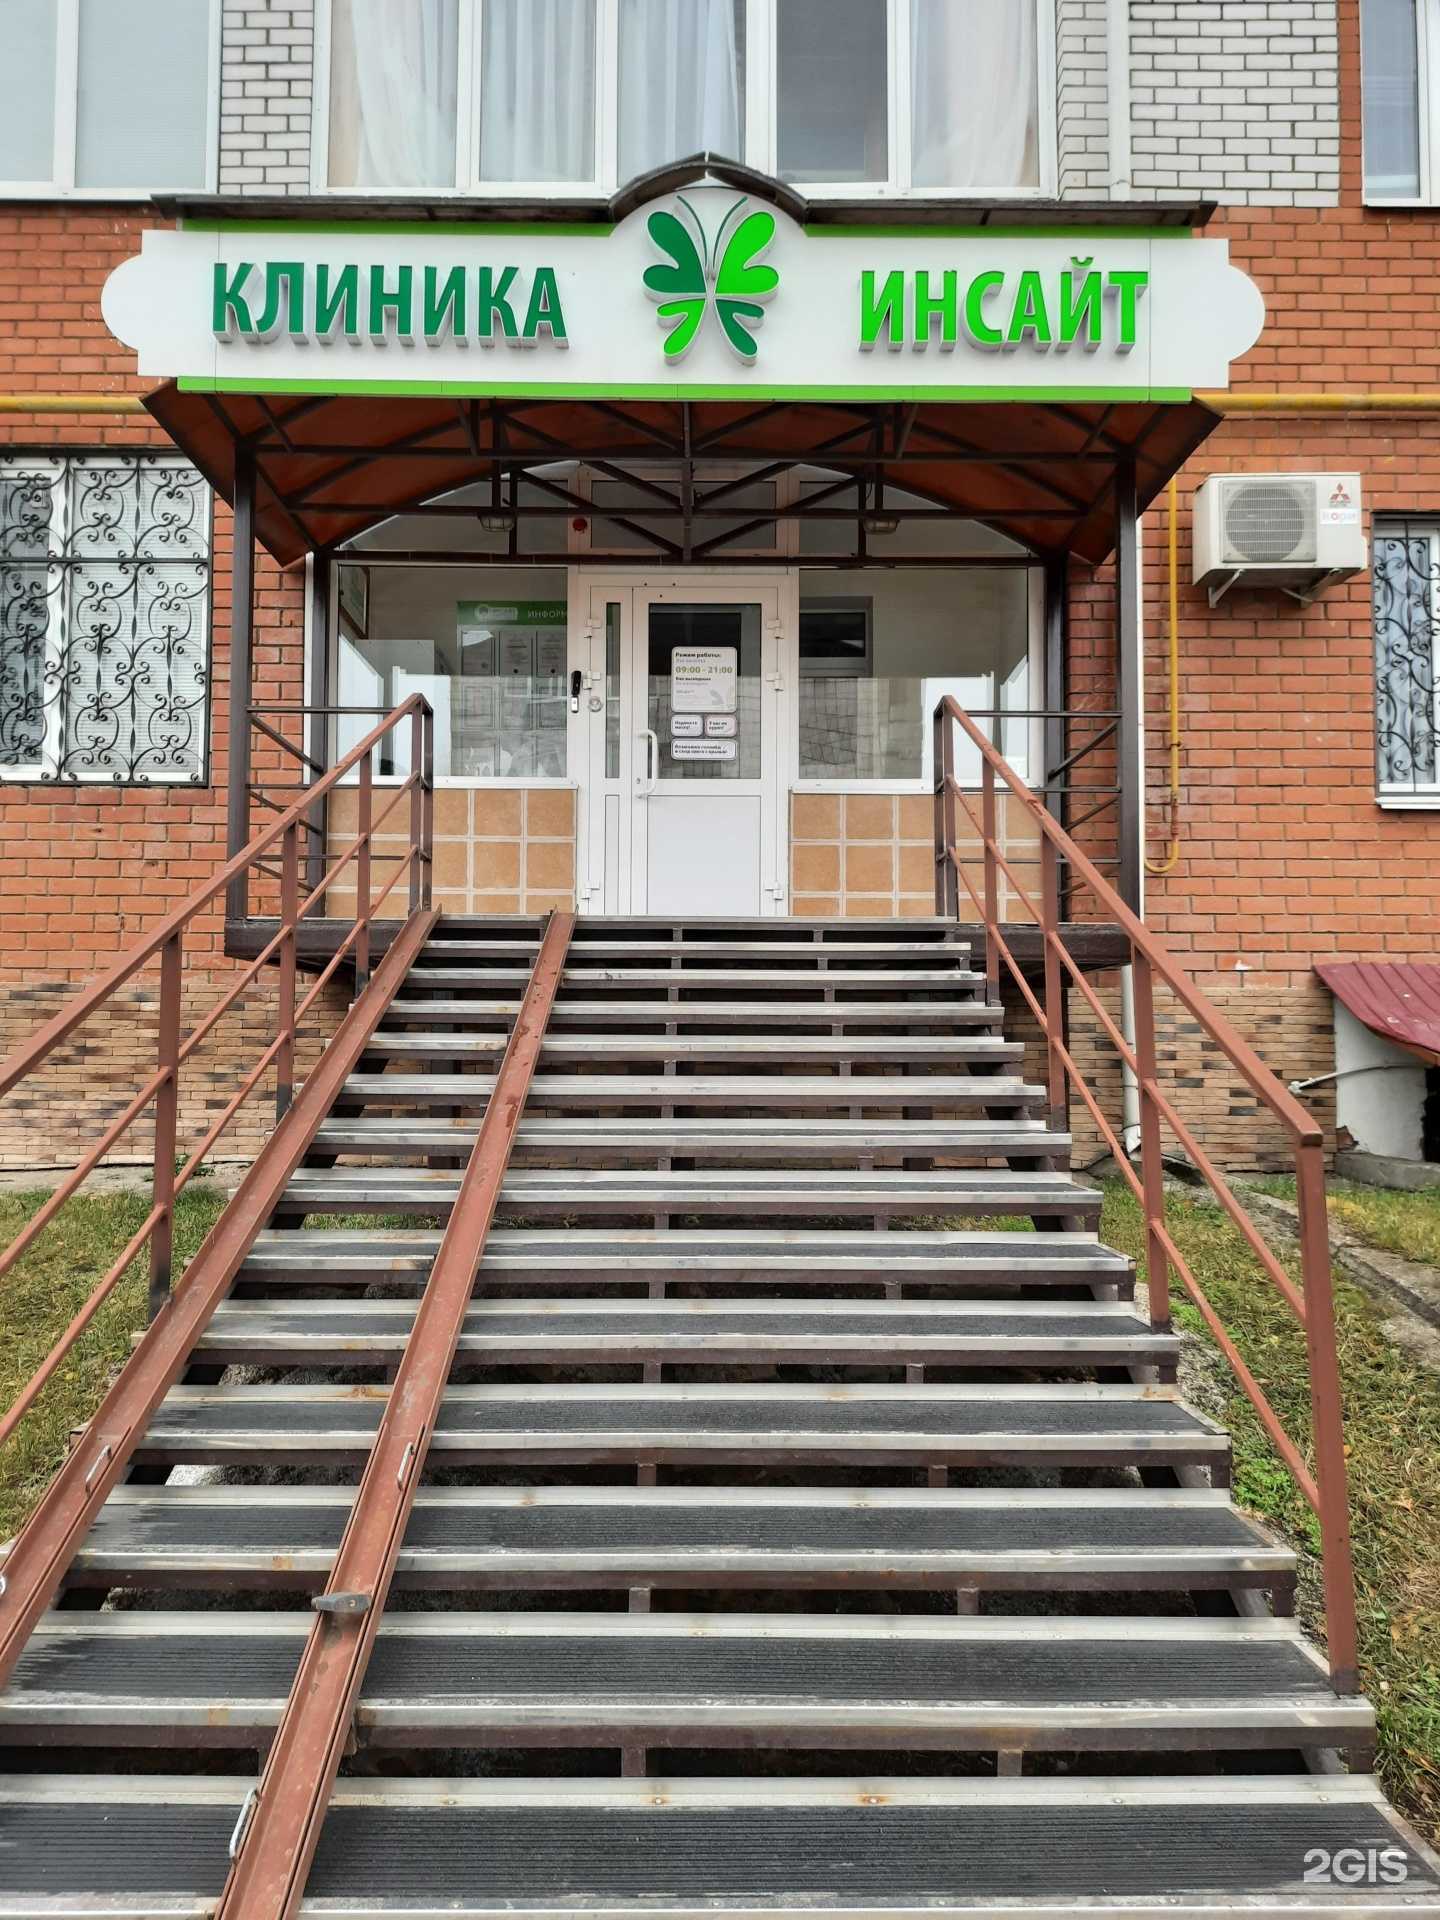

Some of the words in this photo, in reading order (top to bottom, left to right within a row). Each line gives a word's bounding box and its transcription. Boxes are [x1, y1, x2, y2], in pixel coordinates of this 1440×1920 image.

[212, 262, 569, 343] КЛИНИКА
[859, 256, 1149, 347] ИНСАЙТ
[675, 666, 701, 674] 09:00
[707, 666, 733, 674] 21:00
